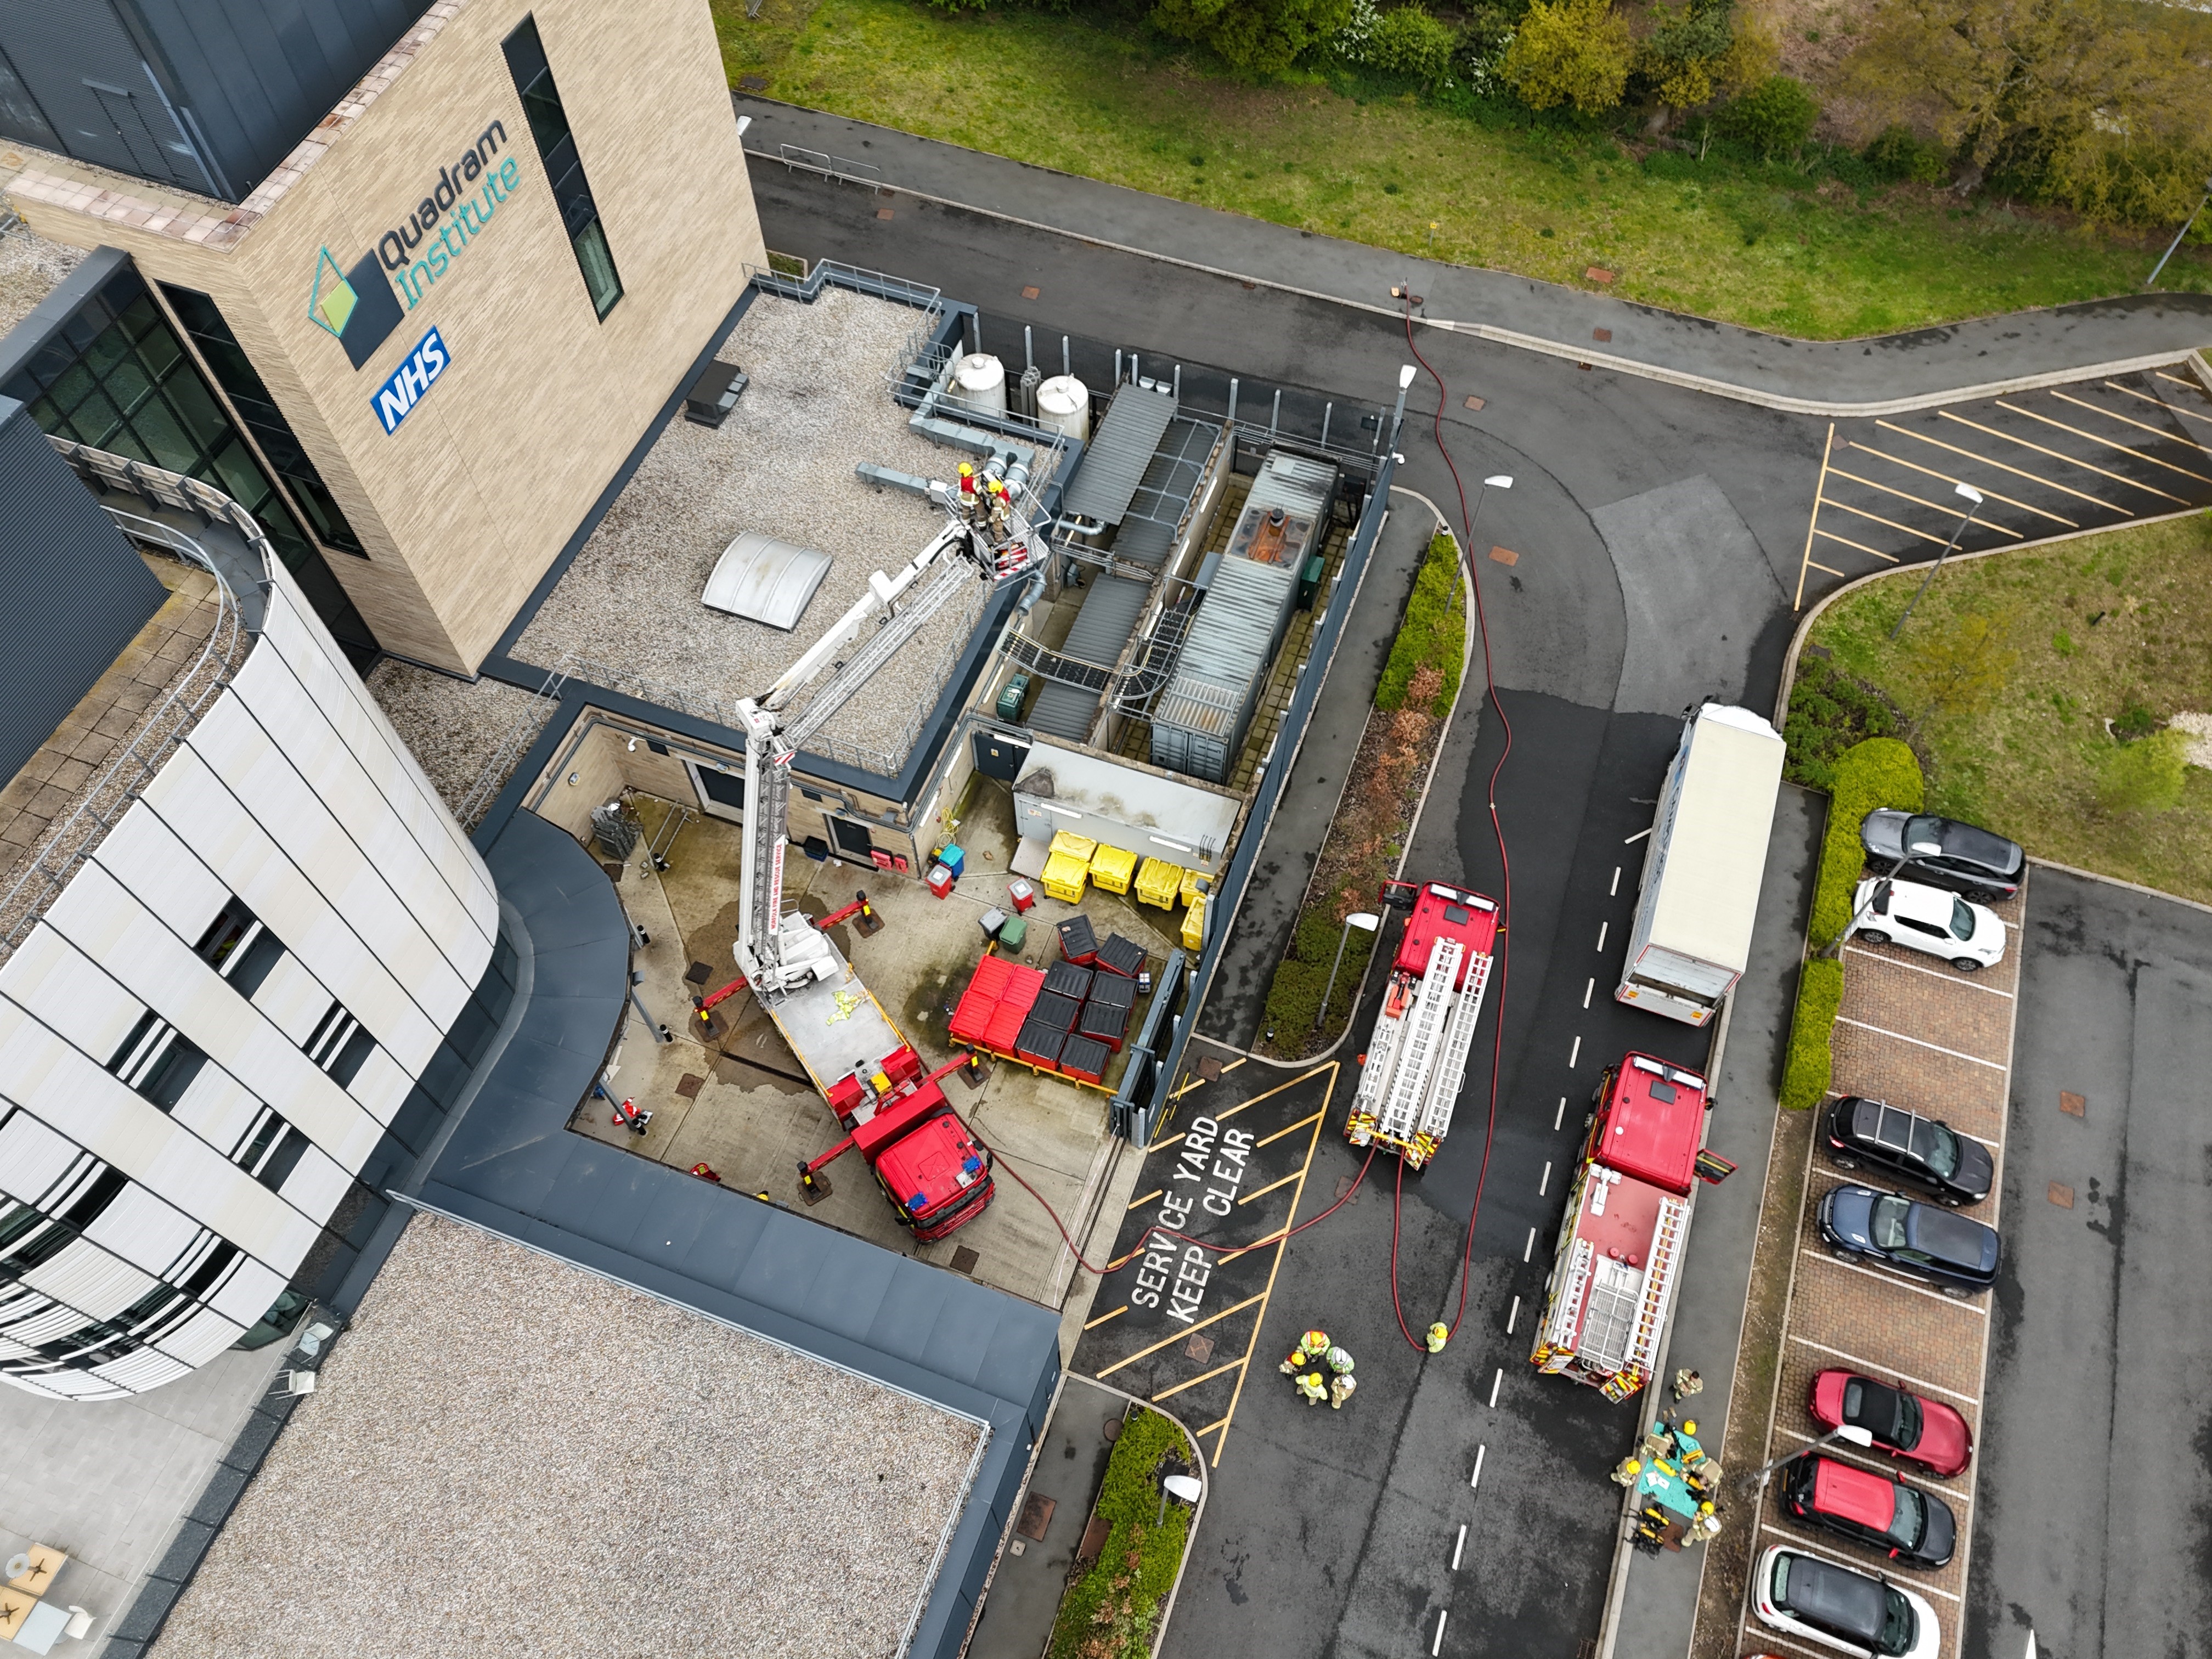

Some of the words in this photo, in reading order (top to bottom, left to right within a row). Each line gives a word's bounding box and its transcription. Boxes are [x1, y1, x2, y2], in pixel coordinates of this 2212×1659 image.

[379, 119, 507, 270] Quadram
[395, 157, 521, 310] Institute
[379, 332, 444, 431] NHS
[1173, 1116, 1218, 1182] YARD
[1166, 1246, 1212, 1324] KEEP
[1203, 1128, 1255, 1216] CLEAR
